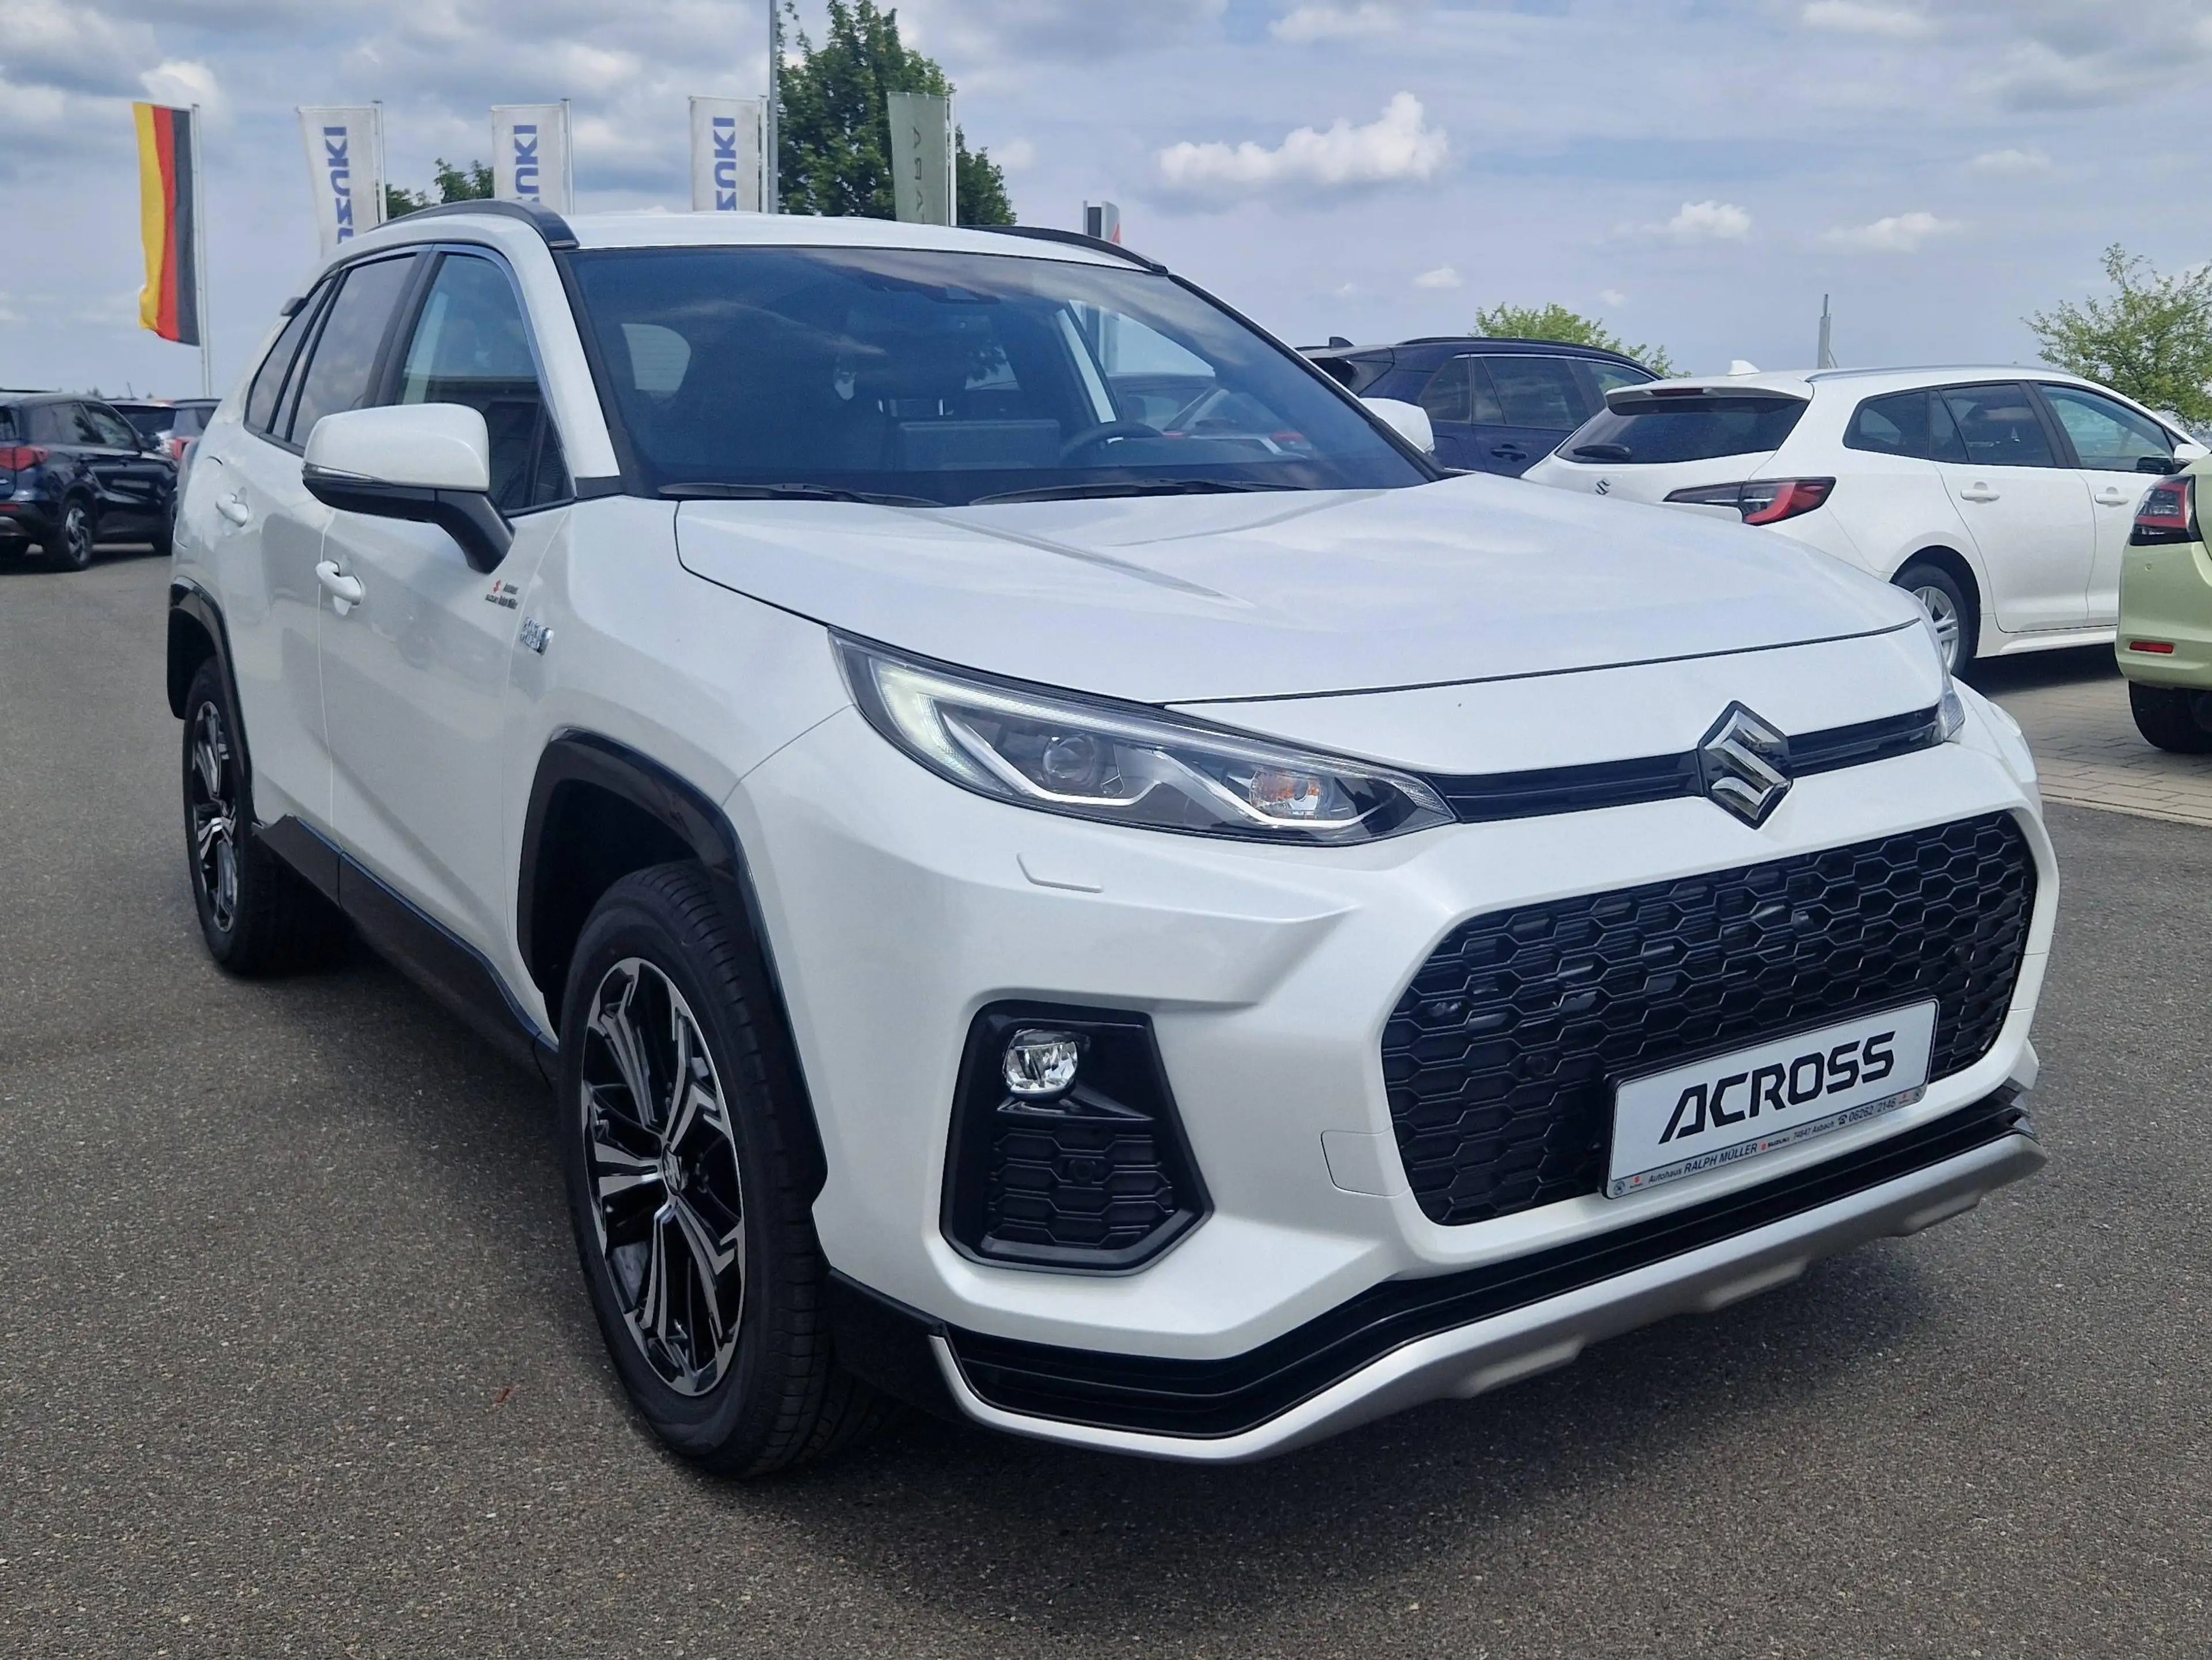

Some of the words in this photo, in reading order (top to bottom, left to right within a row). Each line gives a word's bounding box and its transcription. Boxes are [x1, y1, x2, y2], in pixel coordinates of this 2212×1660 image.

[1658, 1031, 1896, 1145] ACROSS
[1648, 1167, 1682, 1183] Autohaus
[1683, 1155, 1718, 1174] RALPH
[1719, 1143, 1758, 1163] MÜLLER
